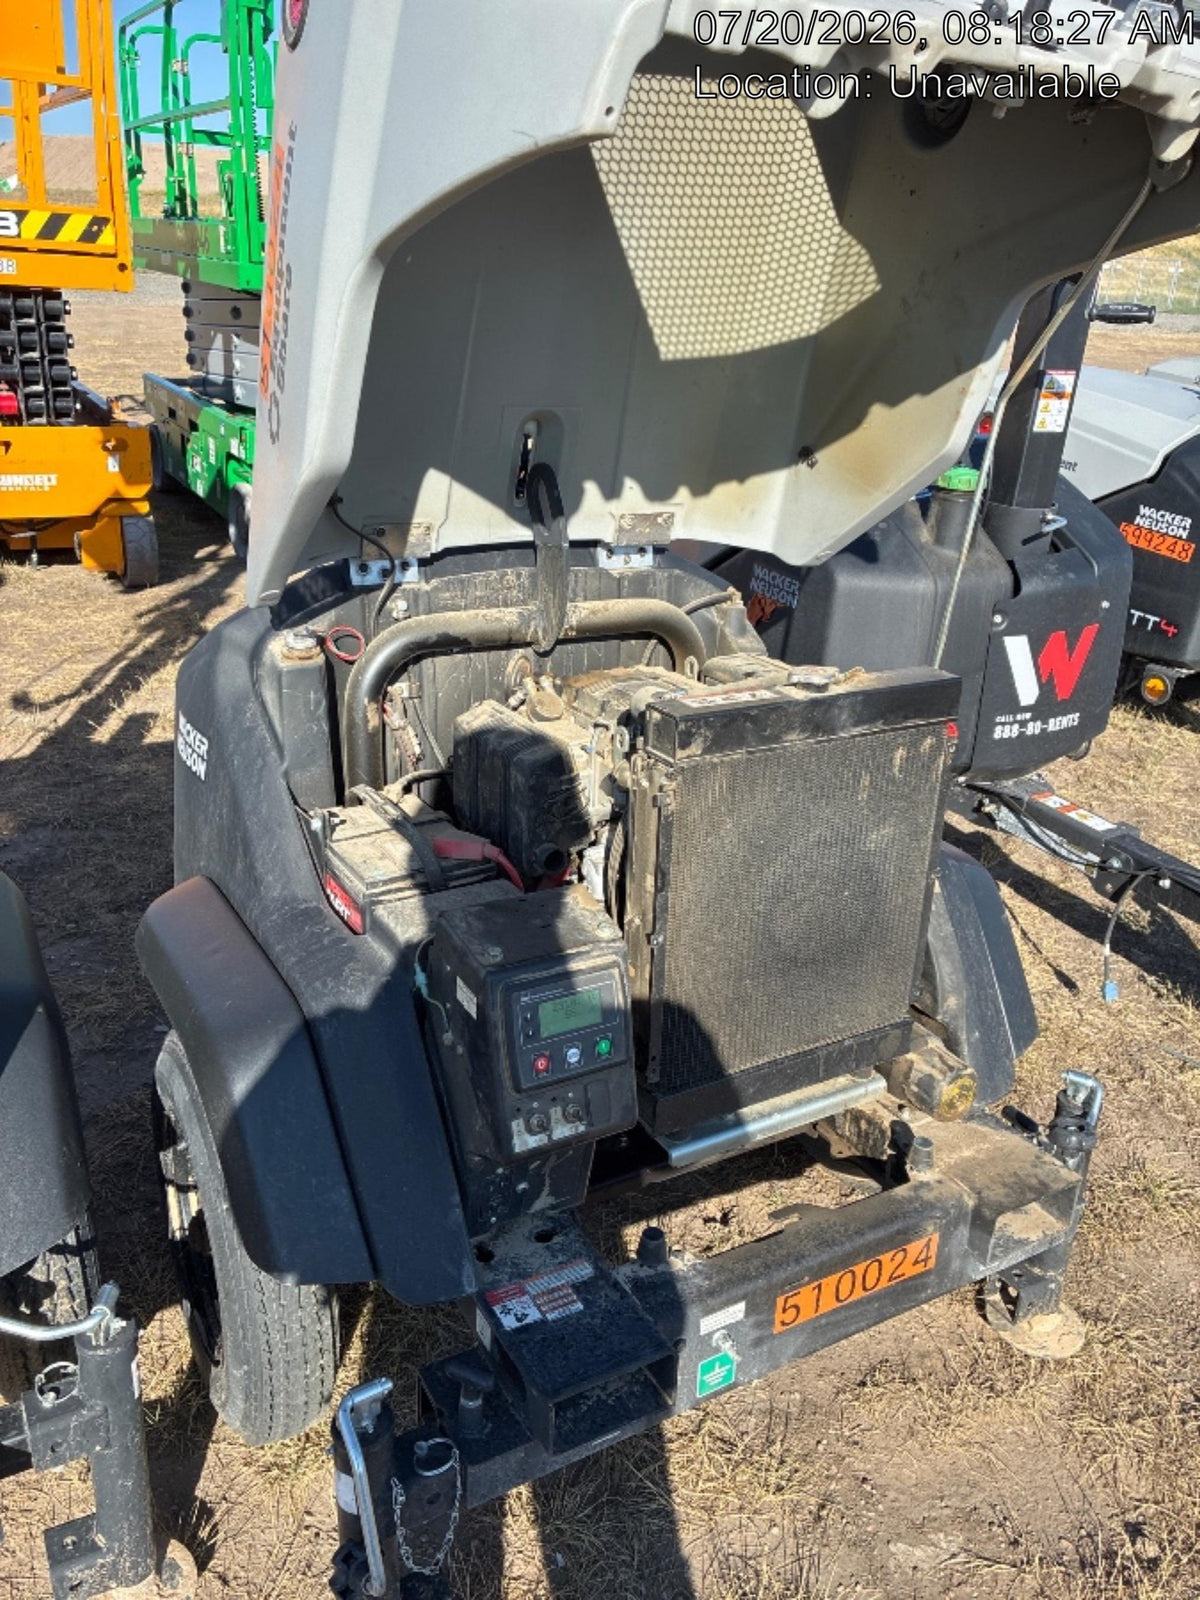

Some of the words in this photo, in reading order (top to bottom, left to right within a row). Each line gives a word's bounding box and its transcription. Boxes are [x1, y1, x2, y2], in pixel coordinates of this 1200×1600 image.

[1134, 515, 1190, 540] NEUSON
[1138, 504, 1192, 529] WACKER
[753, 563, 800, 593] WACKER
[750, 577, 799, 609] NEUSON
[993, 712, 1080, 740] 888-80-RENTS
[780, 1237, 933, 1327] 510024
